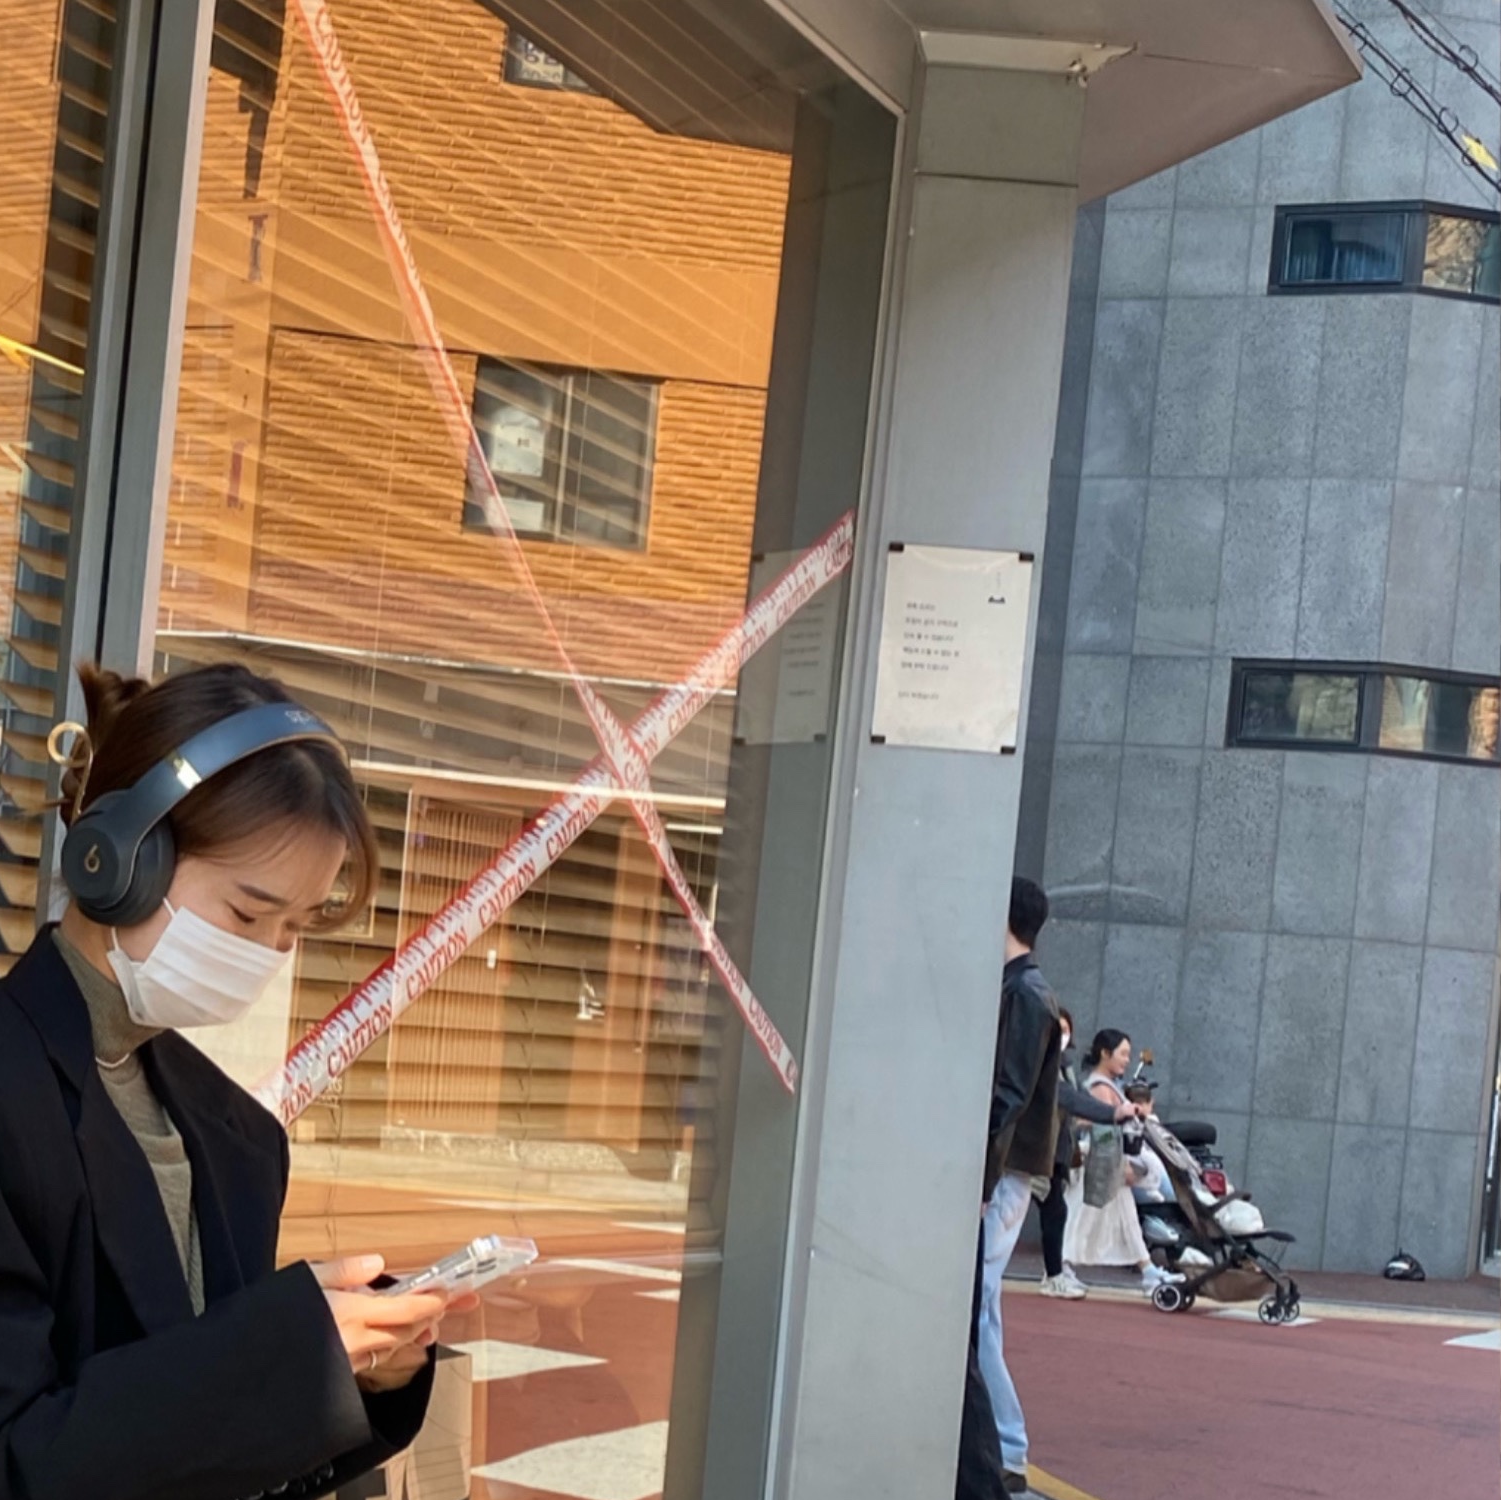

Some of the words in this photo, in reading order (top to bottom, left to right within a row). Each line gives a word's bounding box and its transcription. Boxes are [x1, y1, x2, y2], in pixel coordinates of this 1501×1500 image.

[325, 998, 394, 1078] CAUTION
[404, 925, 467, 1001] CAUTION
[477, 857, 536, 929] CAUTION
[545, 792, 599, 859] CAUTION
[773, 571, 818, 626] CAUTION
[744, 994, 787, 1060] CAUTION
